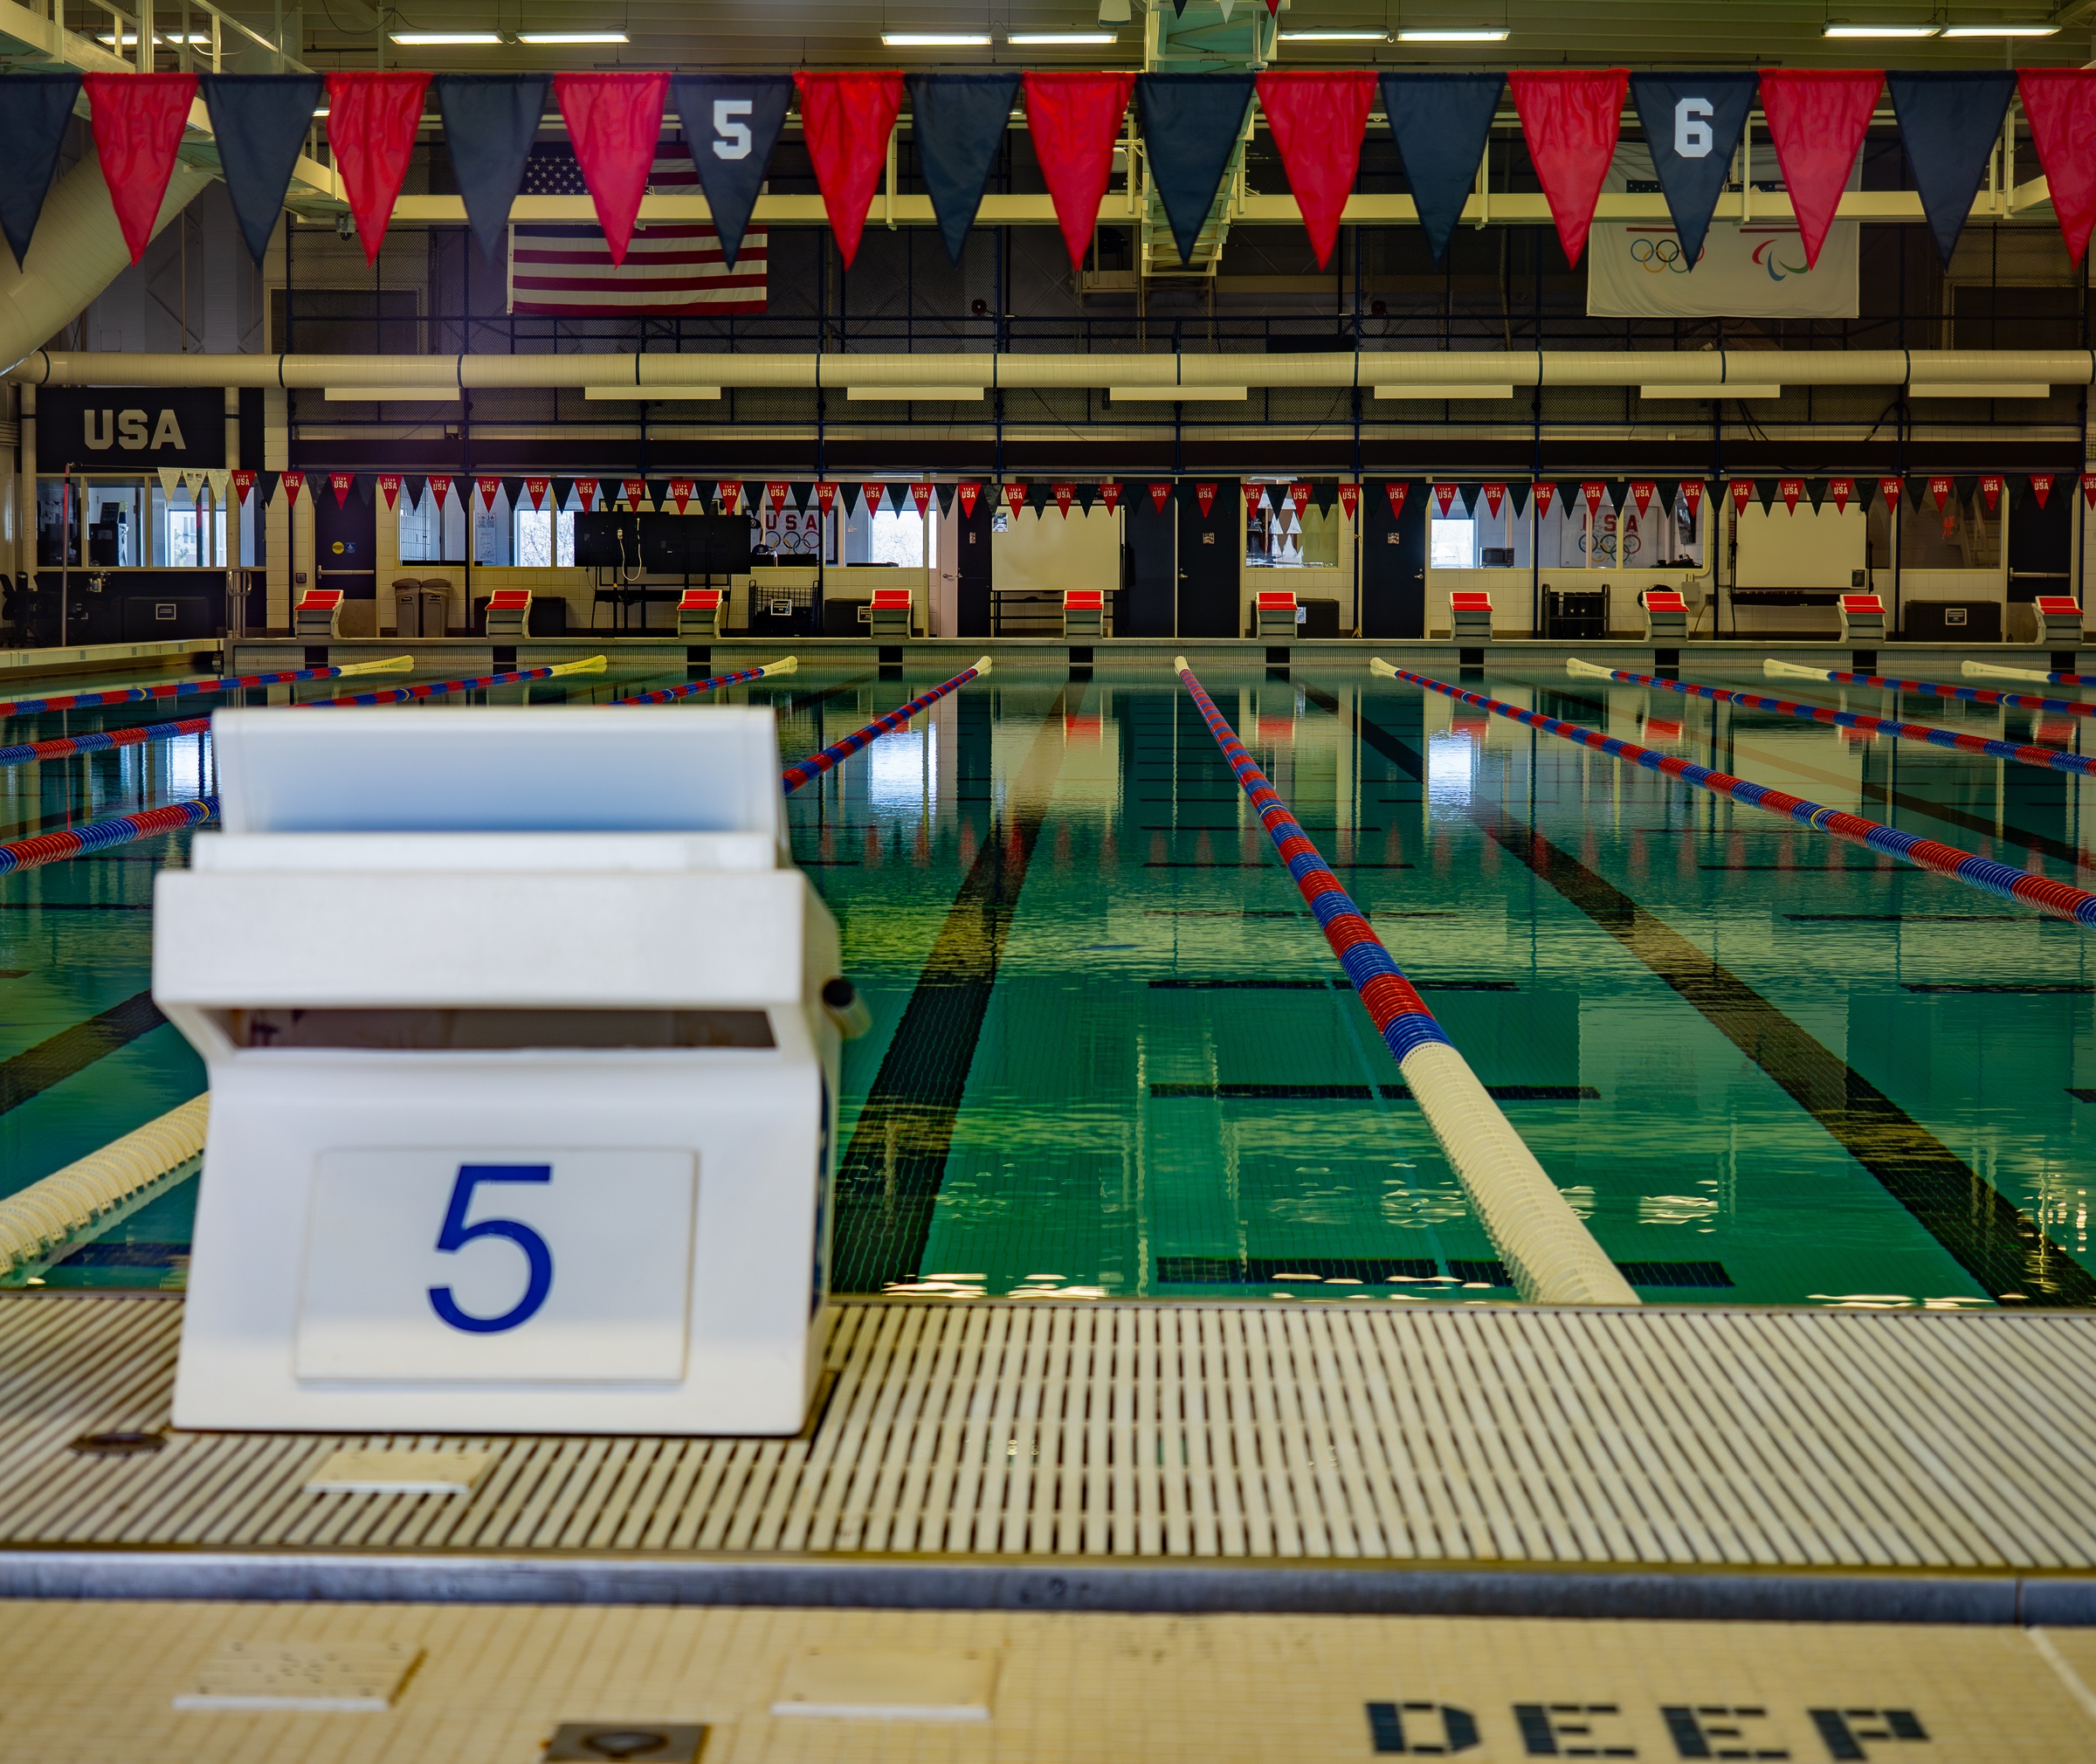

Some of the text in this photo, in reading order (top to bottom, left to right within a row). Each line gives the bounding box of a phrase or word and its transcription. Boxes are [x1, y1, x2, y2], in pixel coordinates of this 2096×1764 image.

[712, 100, 754, 160] 5
[1673, 98, 1713, 158] 6
[84, 409, 187, 450] USA
[428, 1163, 554, 1334] 5
[1365, 1702, 1931, 1761] DEEP
